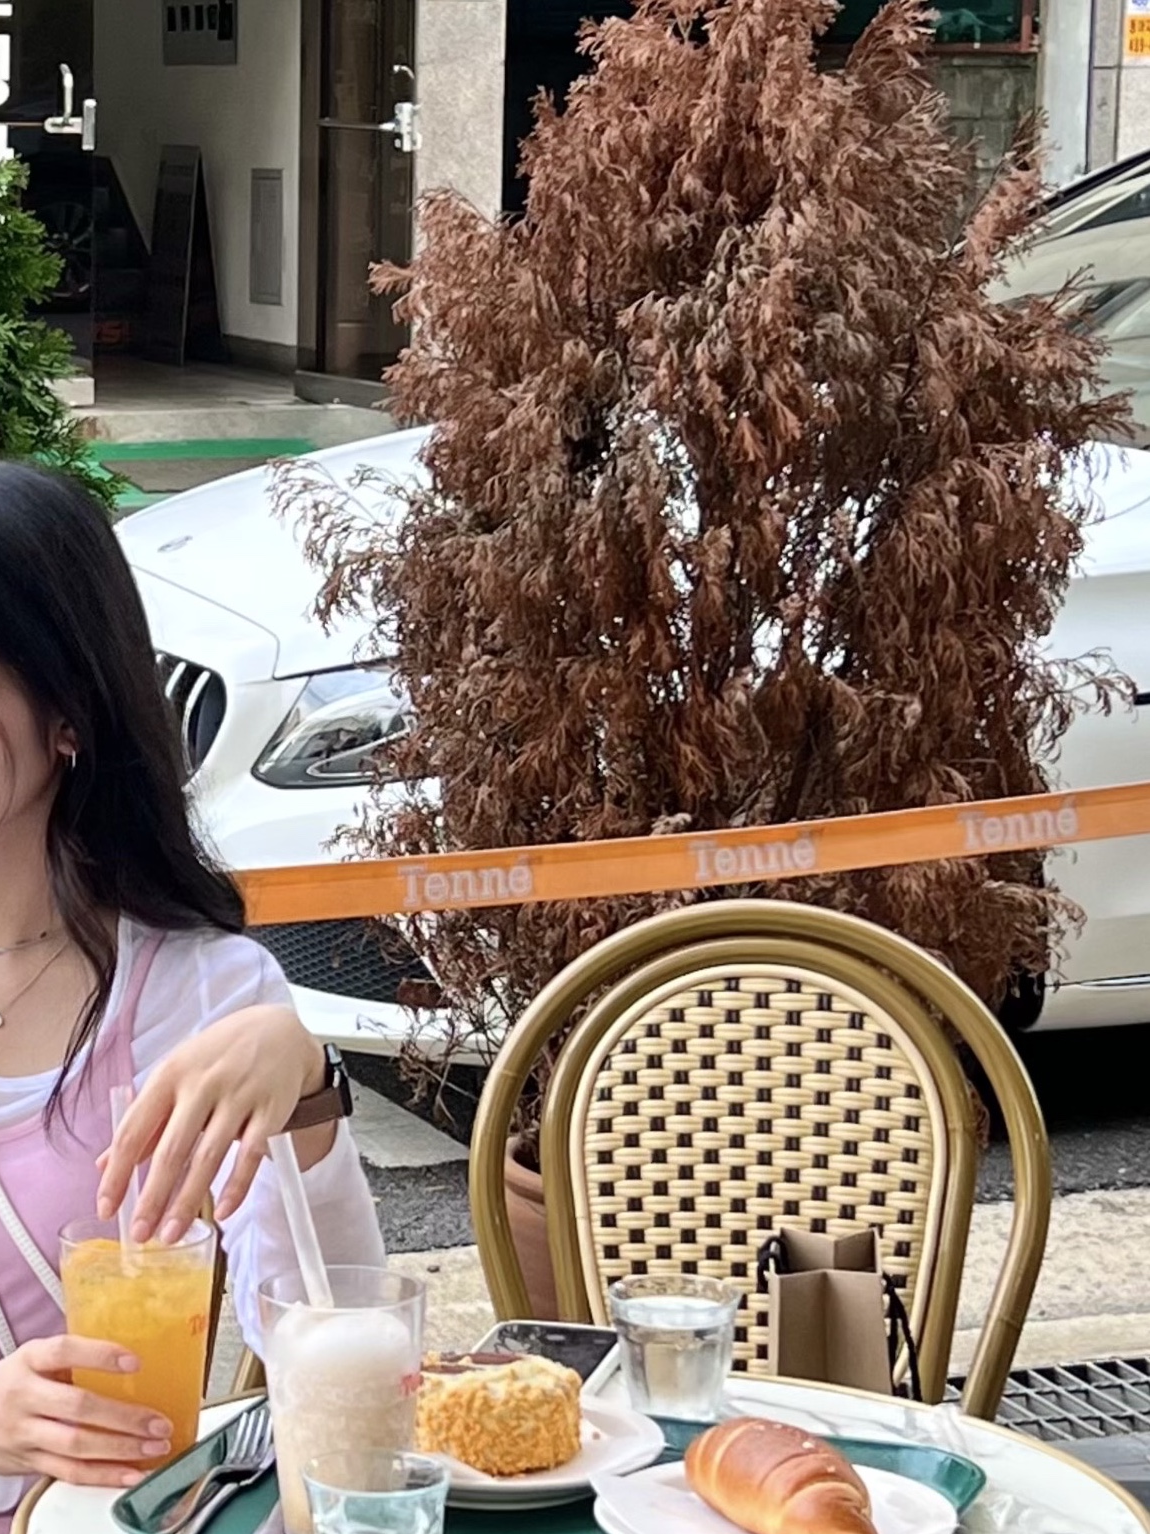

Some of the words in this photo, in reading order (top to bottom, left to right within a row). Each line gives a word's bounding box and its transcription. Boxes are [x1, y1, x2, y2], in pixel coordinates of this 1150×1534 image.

[398, 855, 533, 907] Tenné
[689, 829, 816, 881] Tenné
[957, 797, 1078, 849] Tenné
